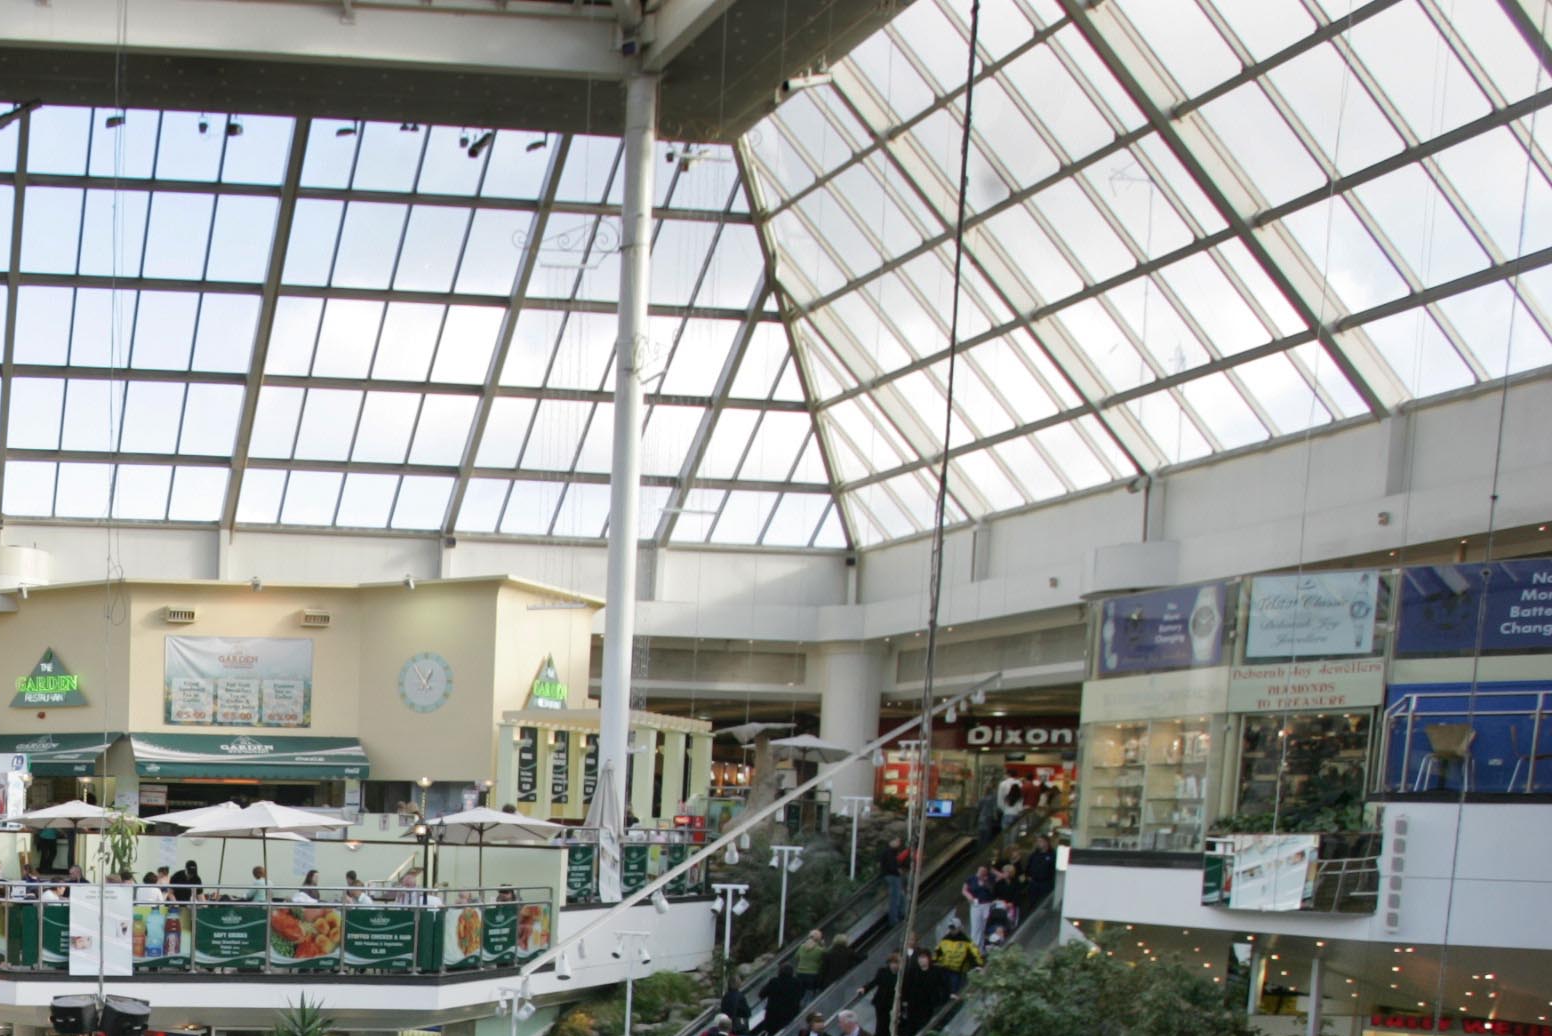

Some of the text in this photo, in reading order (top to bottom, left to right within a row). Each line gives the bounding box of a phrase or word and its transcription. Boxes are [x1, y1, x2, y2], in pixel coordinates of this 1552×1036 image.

[218, 655, 259, 664] GARDEN
[15, 674, 78, 692] GARDEN
[967, 724, 1080, 745] Dixon
